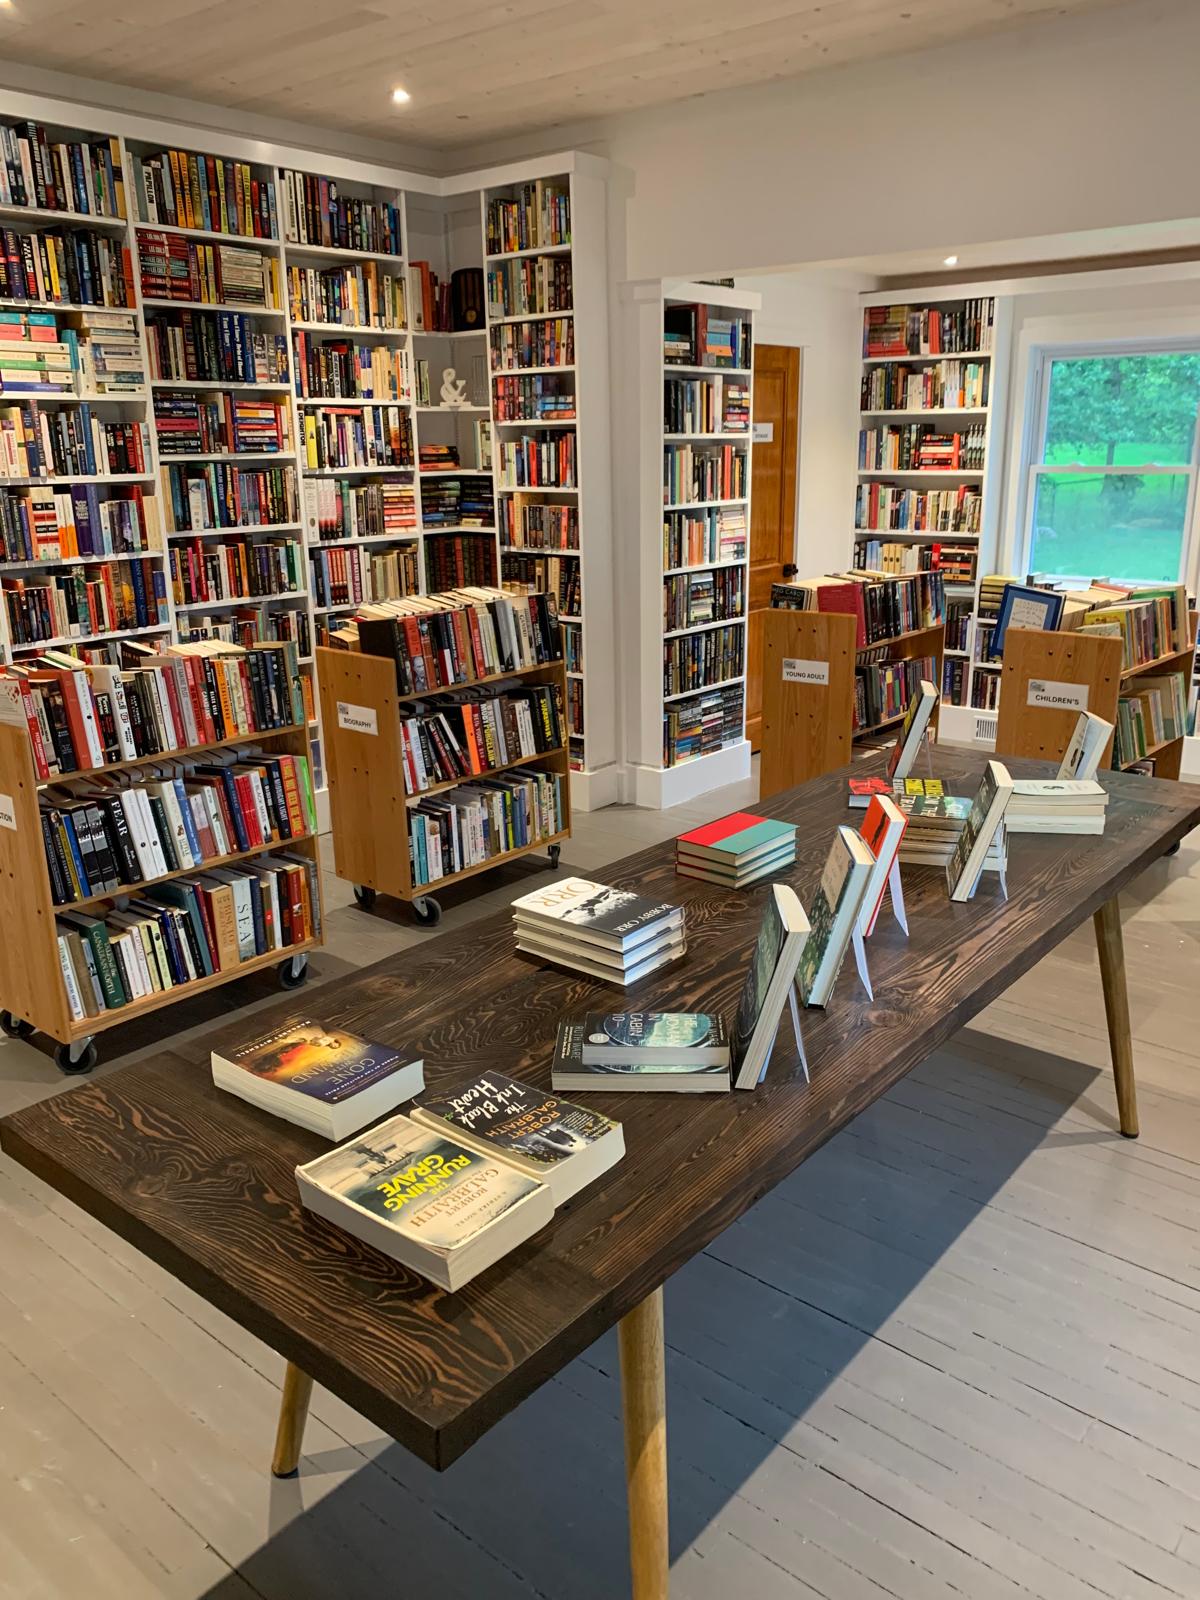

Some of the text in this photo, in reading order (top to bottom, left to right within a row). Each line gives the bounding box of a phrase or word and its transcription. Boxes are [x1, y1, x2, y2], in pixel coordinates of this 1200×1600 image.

[36, 162, 44, 185] BARCLAY
[145, 172, 154, 204] PAPILLON
[220, 684, 230, 720] STALINGRAD
[1035, 694, 1080, 705] CHILDREN'S
[344, 717, 372, 728] BIOGRAPHY
[480, 704, 495, 762] MOBY PORCELAIN
[112, 801, 128, 836] FEAR
[280, 806, 288, 821] LIGHT
[124, 846, 133, 868] Woodward
[541, 882, 597, 907] ORR
[238, 904, 251, 942] SEA
[612, 903, 674, 932] BOBBY ORR
[93, 931, 115, 994] CANADIAN NORTH
[236, 1020, 311, 1058] MARGARET MITCHELL
[630, 1014, 643, 1036] CABIN
[570, 1026, 584, 1060] RUTH WARE
[291, 1060, 334, 1084] WIND
[326, 1058, 375, 1084] GONE
[447, 1079, 498, 1114] Heart
[456, 1083, 526, 1129] Ink Black
[504, 1102, 527, 1115] the
[484, 1100, 557, 1137] GALBRAITH
[508, 1110, 561, 1140] ROBERT
[376, 1154, 444, 1198] GRAVE
[383, 1154, 472, 1212] RUNNING
[430, 1182, 450, 1195] THE
[410, 1168, 499, 1228] GALBRAITH
[444, 1187, 488, 1217] ROBERT
